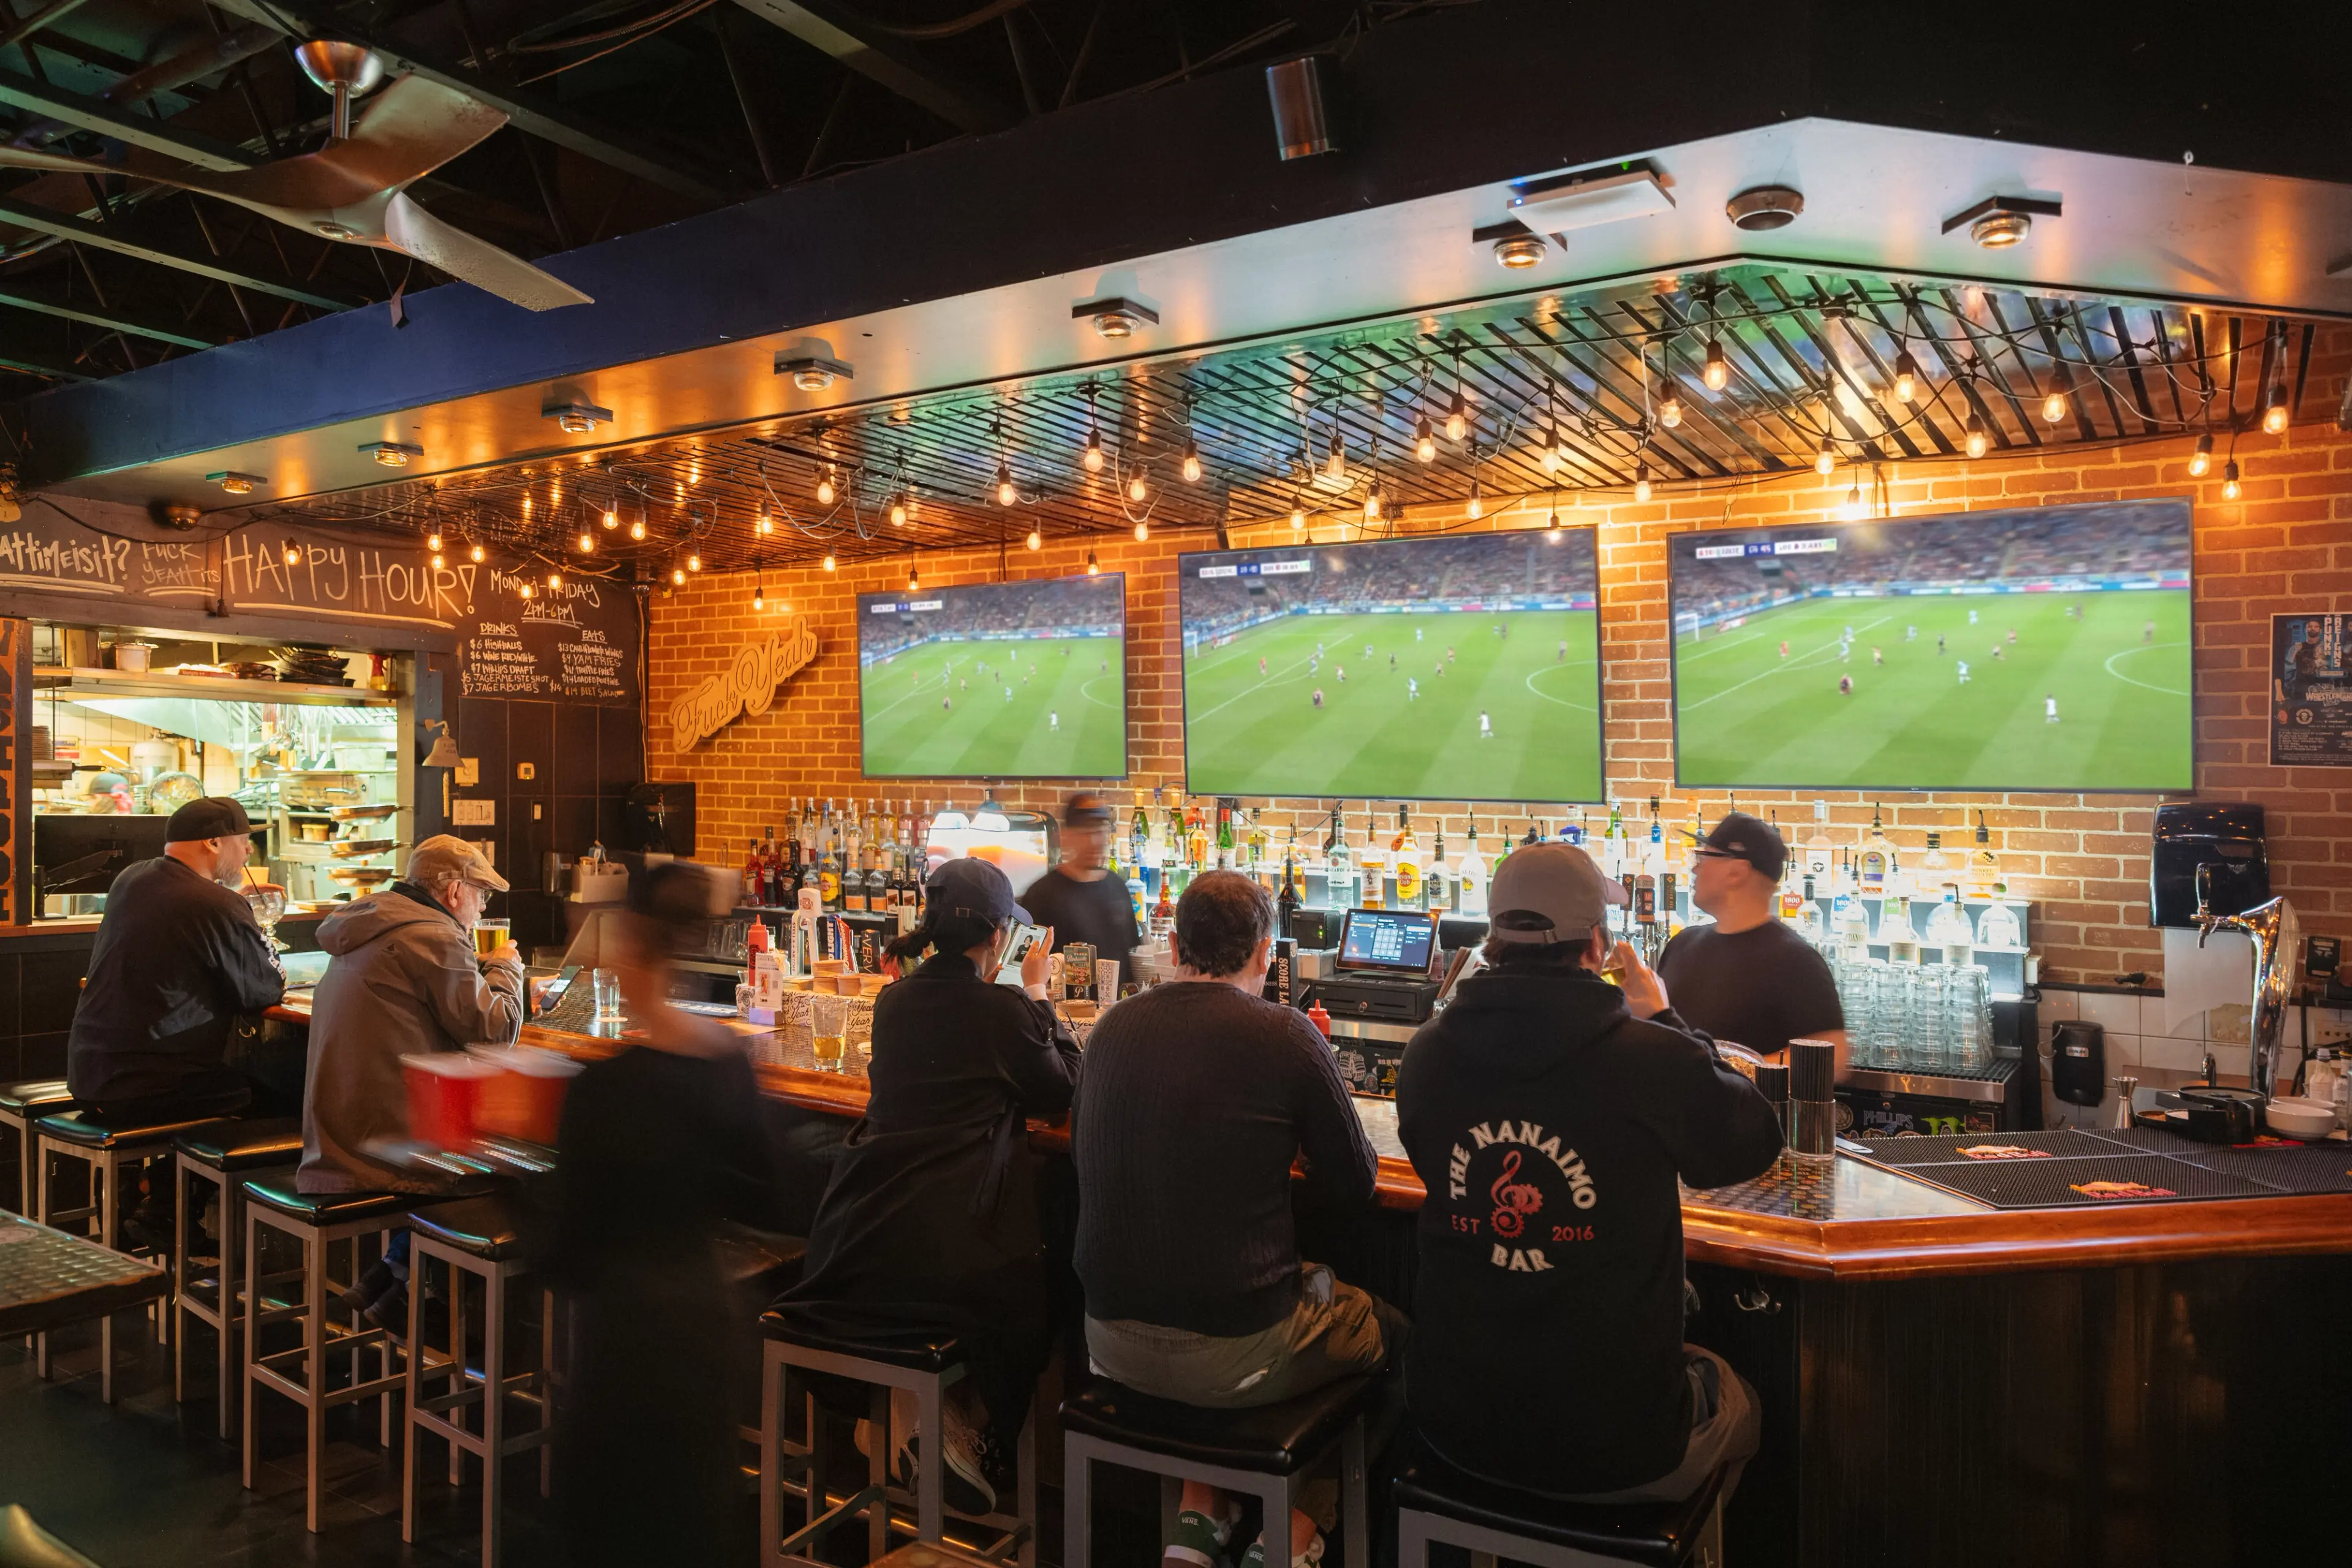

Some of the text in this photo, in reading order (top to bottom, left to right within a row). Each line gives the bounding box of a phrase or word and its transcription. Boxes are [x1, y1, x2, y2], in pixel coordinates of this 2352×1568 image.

[143, 541, 201, 562] FUCK
[142, 560, 200, 586] YEAH
[224, 535, 477, 618] HAPPY HOUR!
[480, 622, 517, 635] DRINKS
[582, 630, 605, 641] EATS
[470, 650, 481, 661] $6
[557, 642, 569, 652] $13
[471, 663, 481, 673] $7
[509, 665, 535, 674] DRAFT
[562, 654, 620, 667] $9 YAM FRIES
[671, 620, 813, 750] Fuck Yeah
[1278, 957, 1290, 1005] SCORE LA
[1863, 1110, 1913, 1129] PHILLIPS
[1450, 1120, 1597, 1210] THE NANAIMO
[1451, 1215, 1480, 1234] EST
[1552, 1226, 1594, 1242] 2016
[1490, 1243, 1555, 1272] BAR
[1182, 1517, 1199, 1526] VANS
